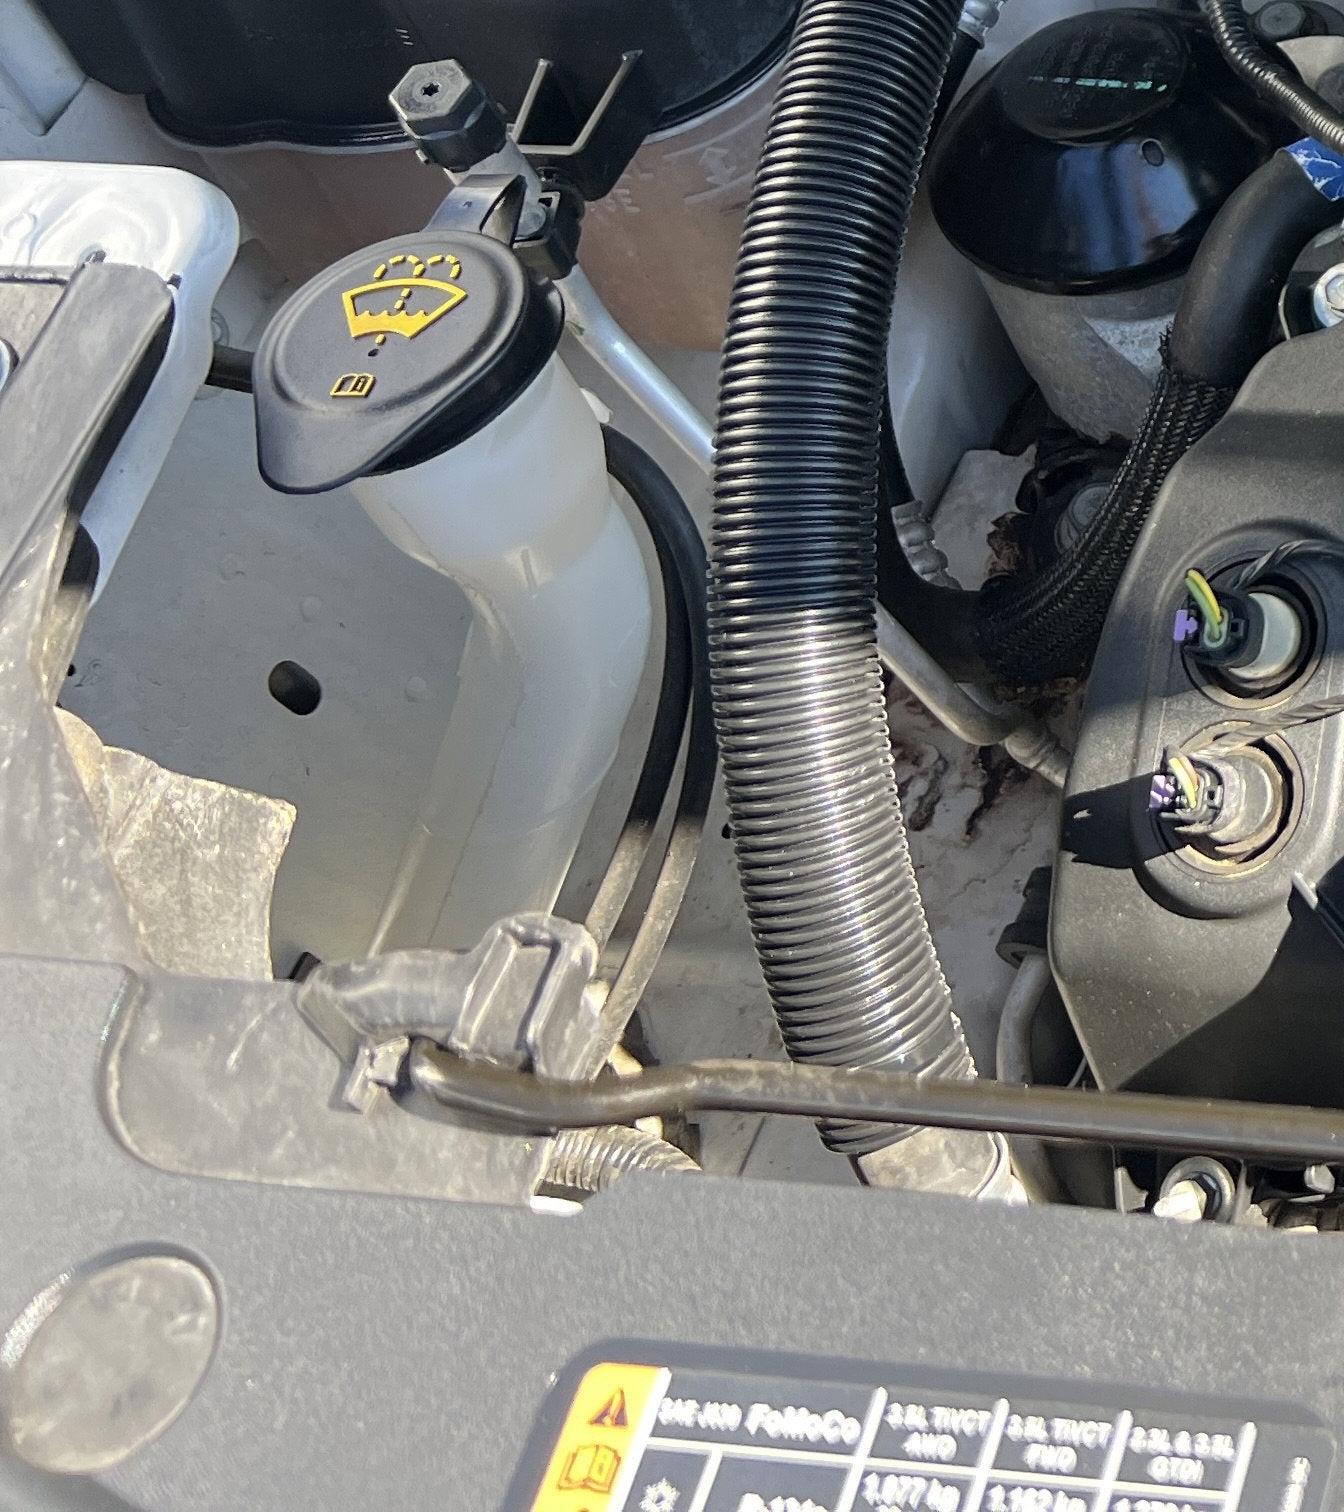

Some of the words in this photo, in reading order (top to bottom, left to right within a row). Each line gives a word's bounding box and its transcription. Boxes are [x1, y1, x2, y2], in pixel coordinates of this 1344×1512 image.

[744, 1402, 861, 1446] FoMoCo
[902, 1431, 958, 1463] AWD
[1023, 1442, 1078, 1474] FWD
